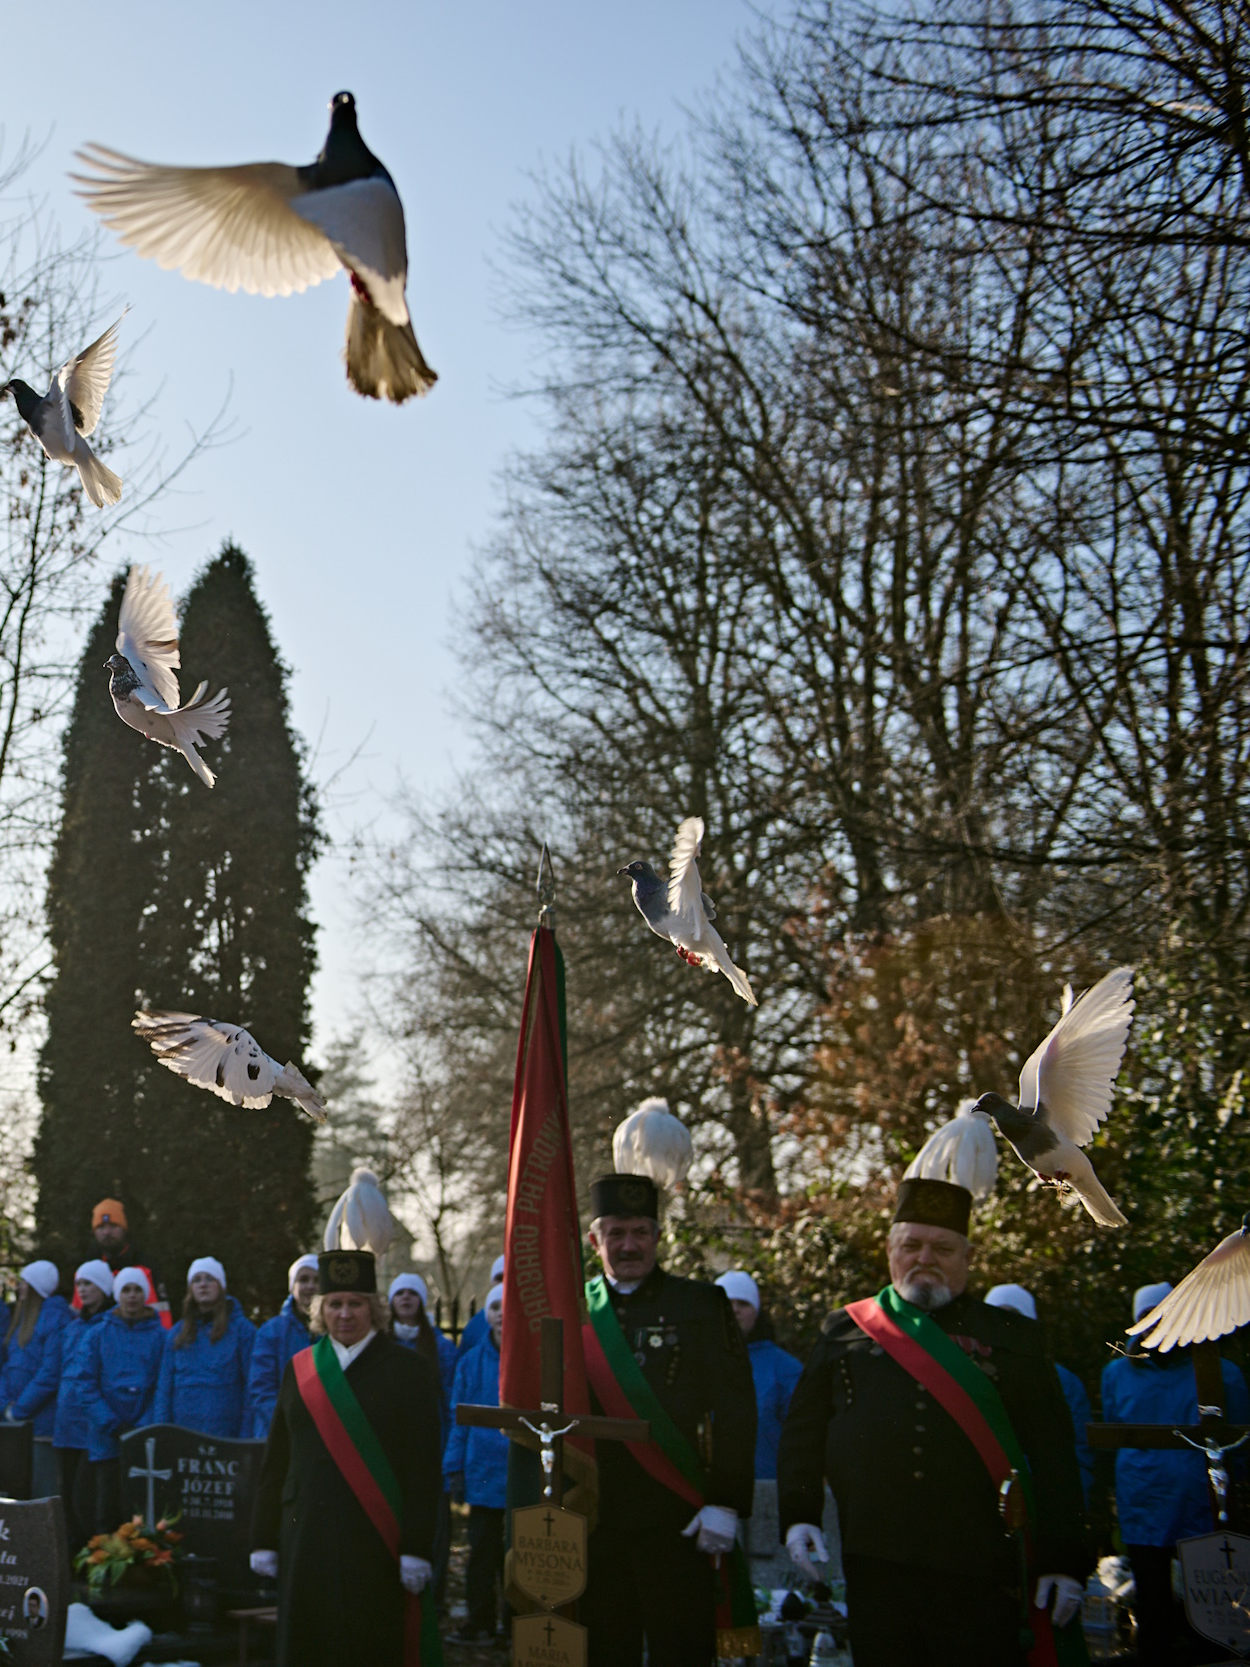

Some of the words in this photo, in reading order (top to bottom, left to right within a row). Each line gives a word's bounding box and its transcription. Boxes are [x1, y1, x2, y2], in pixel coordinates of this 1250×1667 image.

[177, 1457, 239, 1476] FRANC
[180, 1475, 236, 1496] JÓZEF
[518, 1535, 579, 1554] BARBARA
[515, 1550, 584, 1572] MYSONA
[529, 1645, 570, 1664] MARIA
